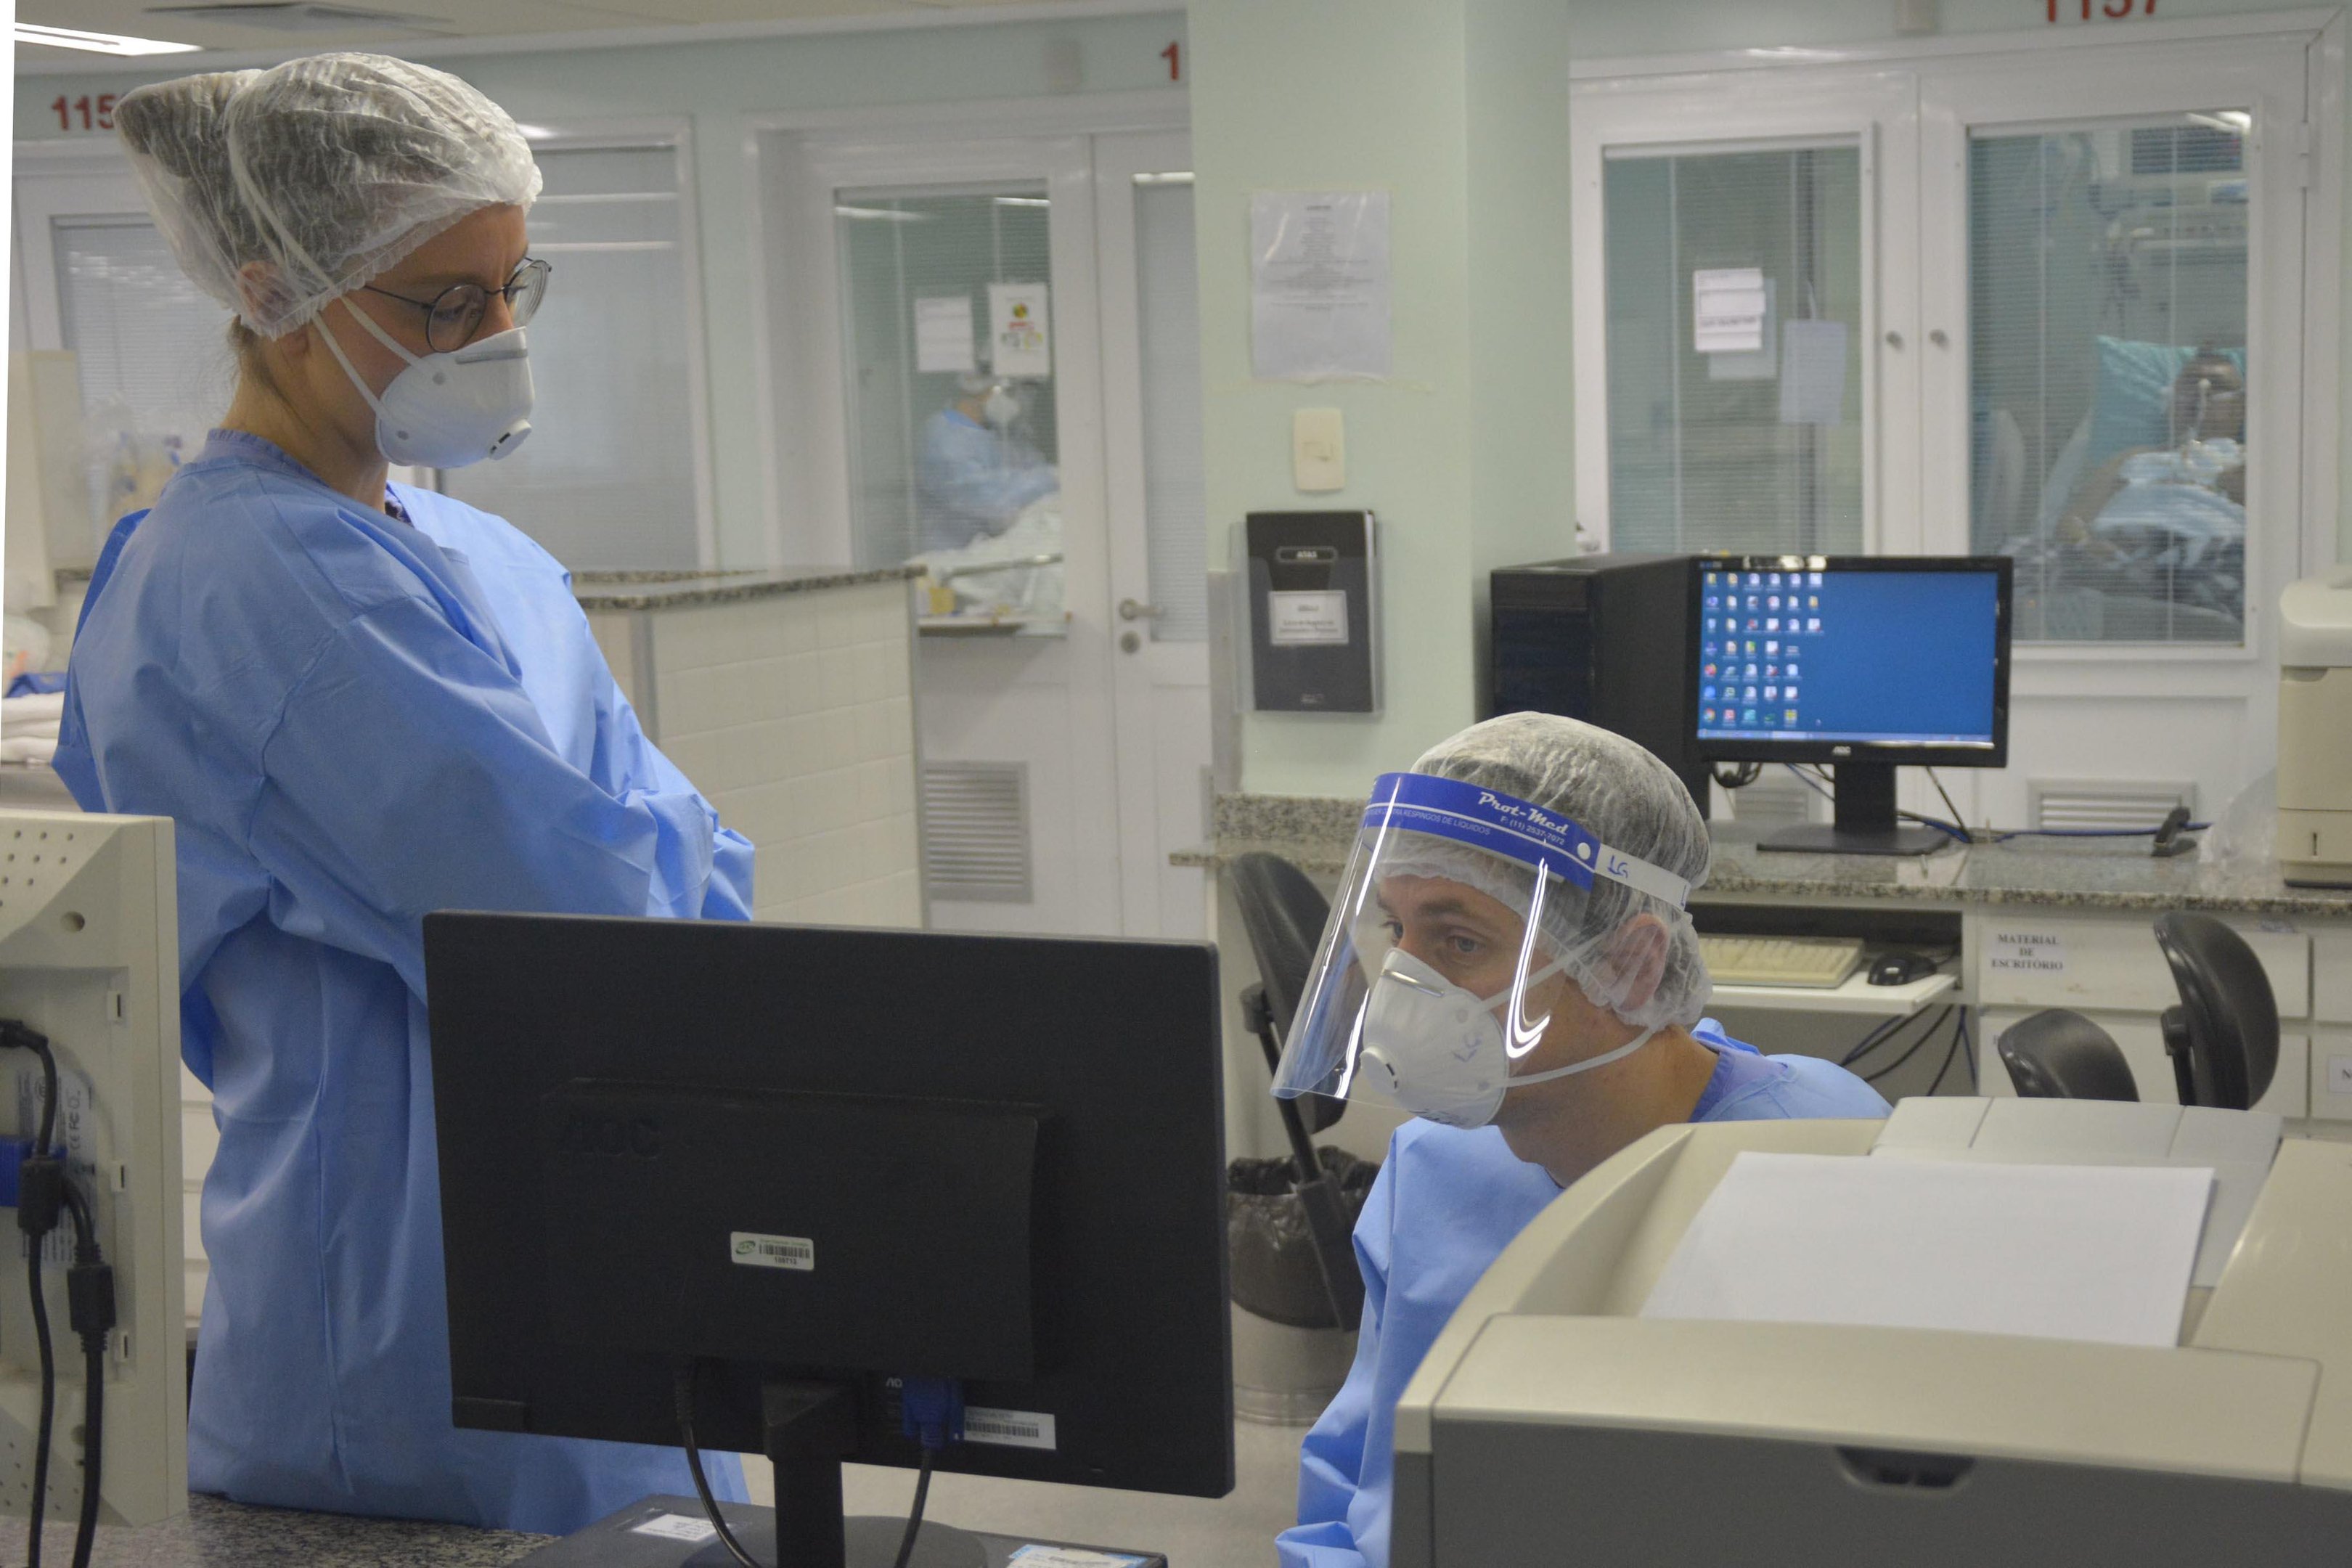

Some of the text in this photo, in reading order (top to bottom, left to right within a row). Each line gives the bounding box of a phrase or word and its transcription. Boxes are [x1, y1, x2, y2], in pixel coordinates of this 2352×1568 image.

[51, 94, 116, 131] 115
[1478, 791, 1569, 835] Prot-Med
[1442, 816, 1452, 825] DE
[1510, 819, 1524, 830] (11)
[1998, 934, 2060, 945] MATERIAL
[2019, 947, 2034, 957] DE
[1991, 957, 2063, 971] ESCRITÓRIO
